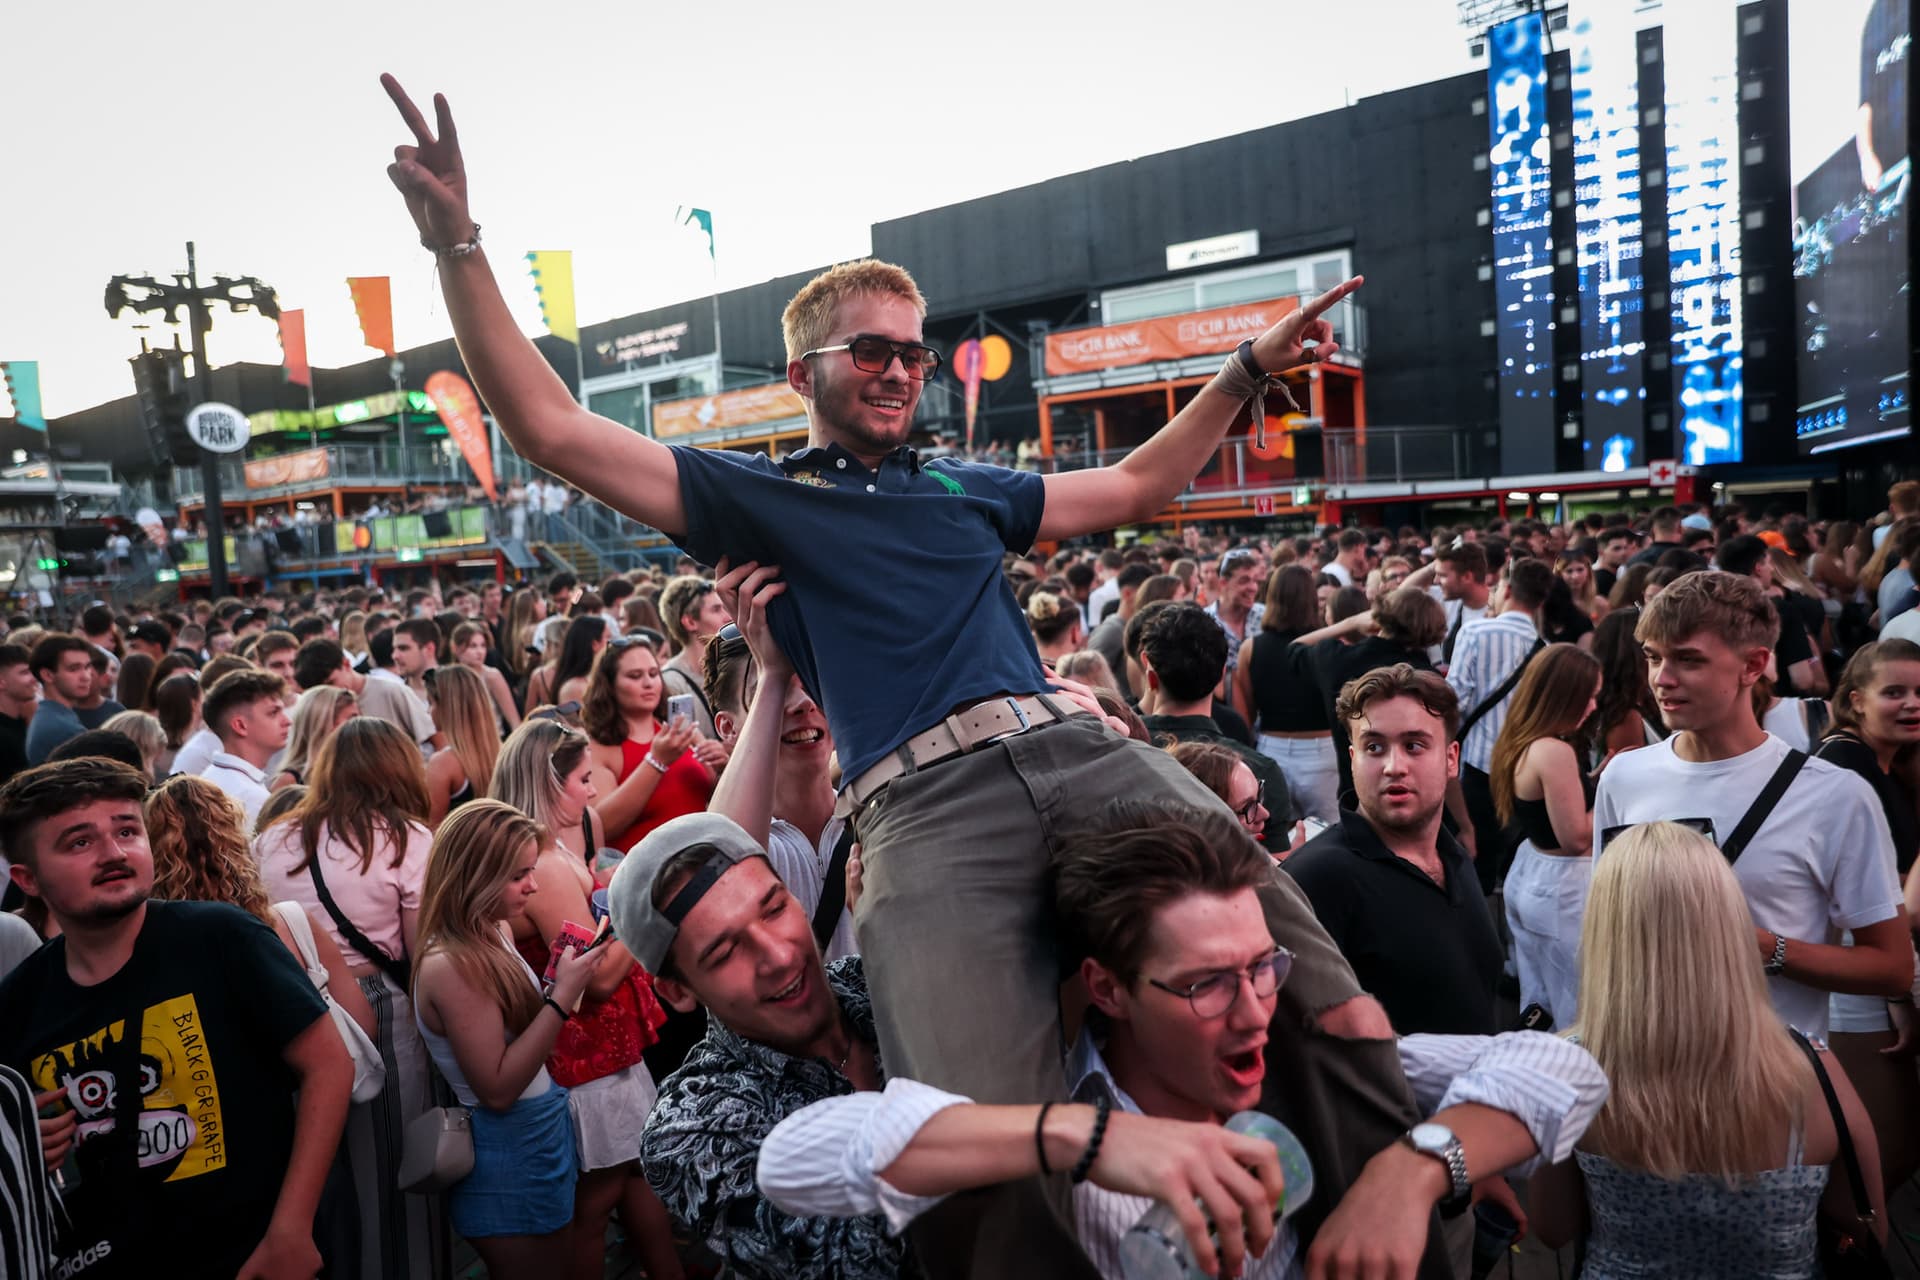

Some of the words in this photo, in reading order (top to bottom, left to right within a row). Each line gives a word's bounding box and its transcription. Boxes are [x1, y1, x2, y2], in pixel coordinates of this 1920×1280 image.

[1226, 311, 1266, 331] BANK
[199, 426, 237, 445] PARK
[172, 1010, 203, 1069] BLACK
[56, 1239, 112, 1280] didas
